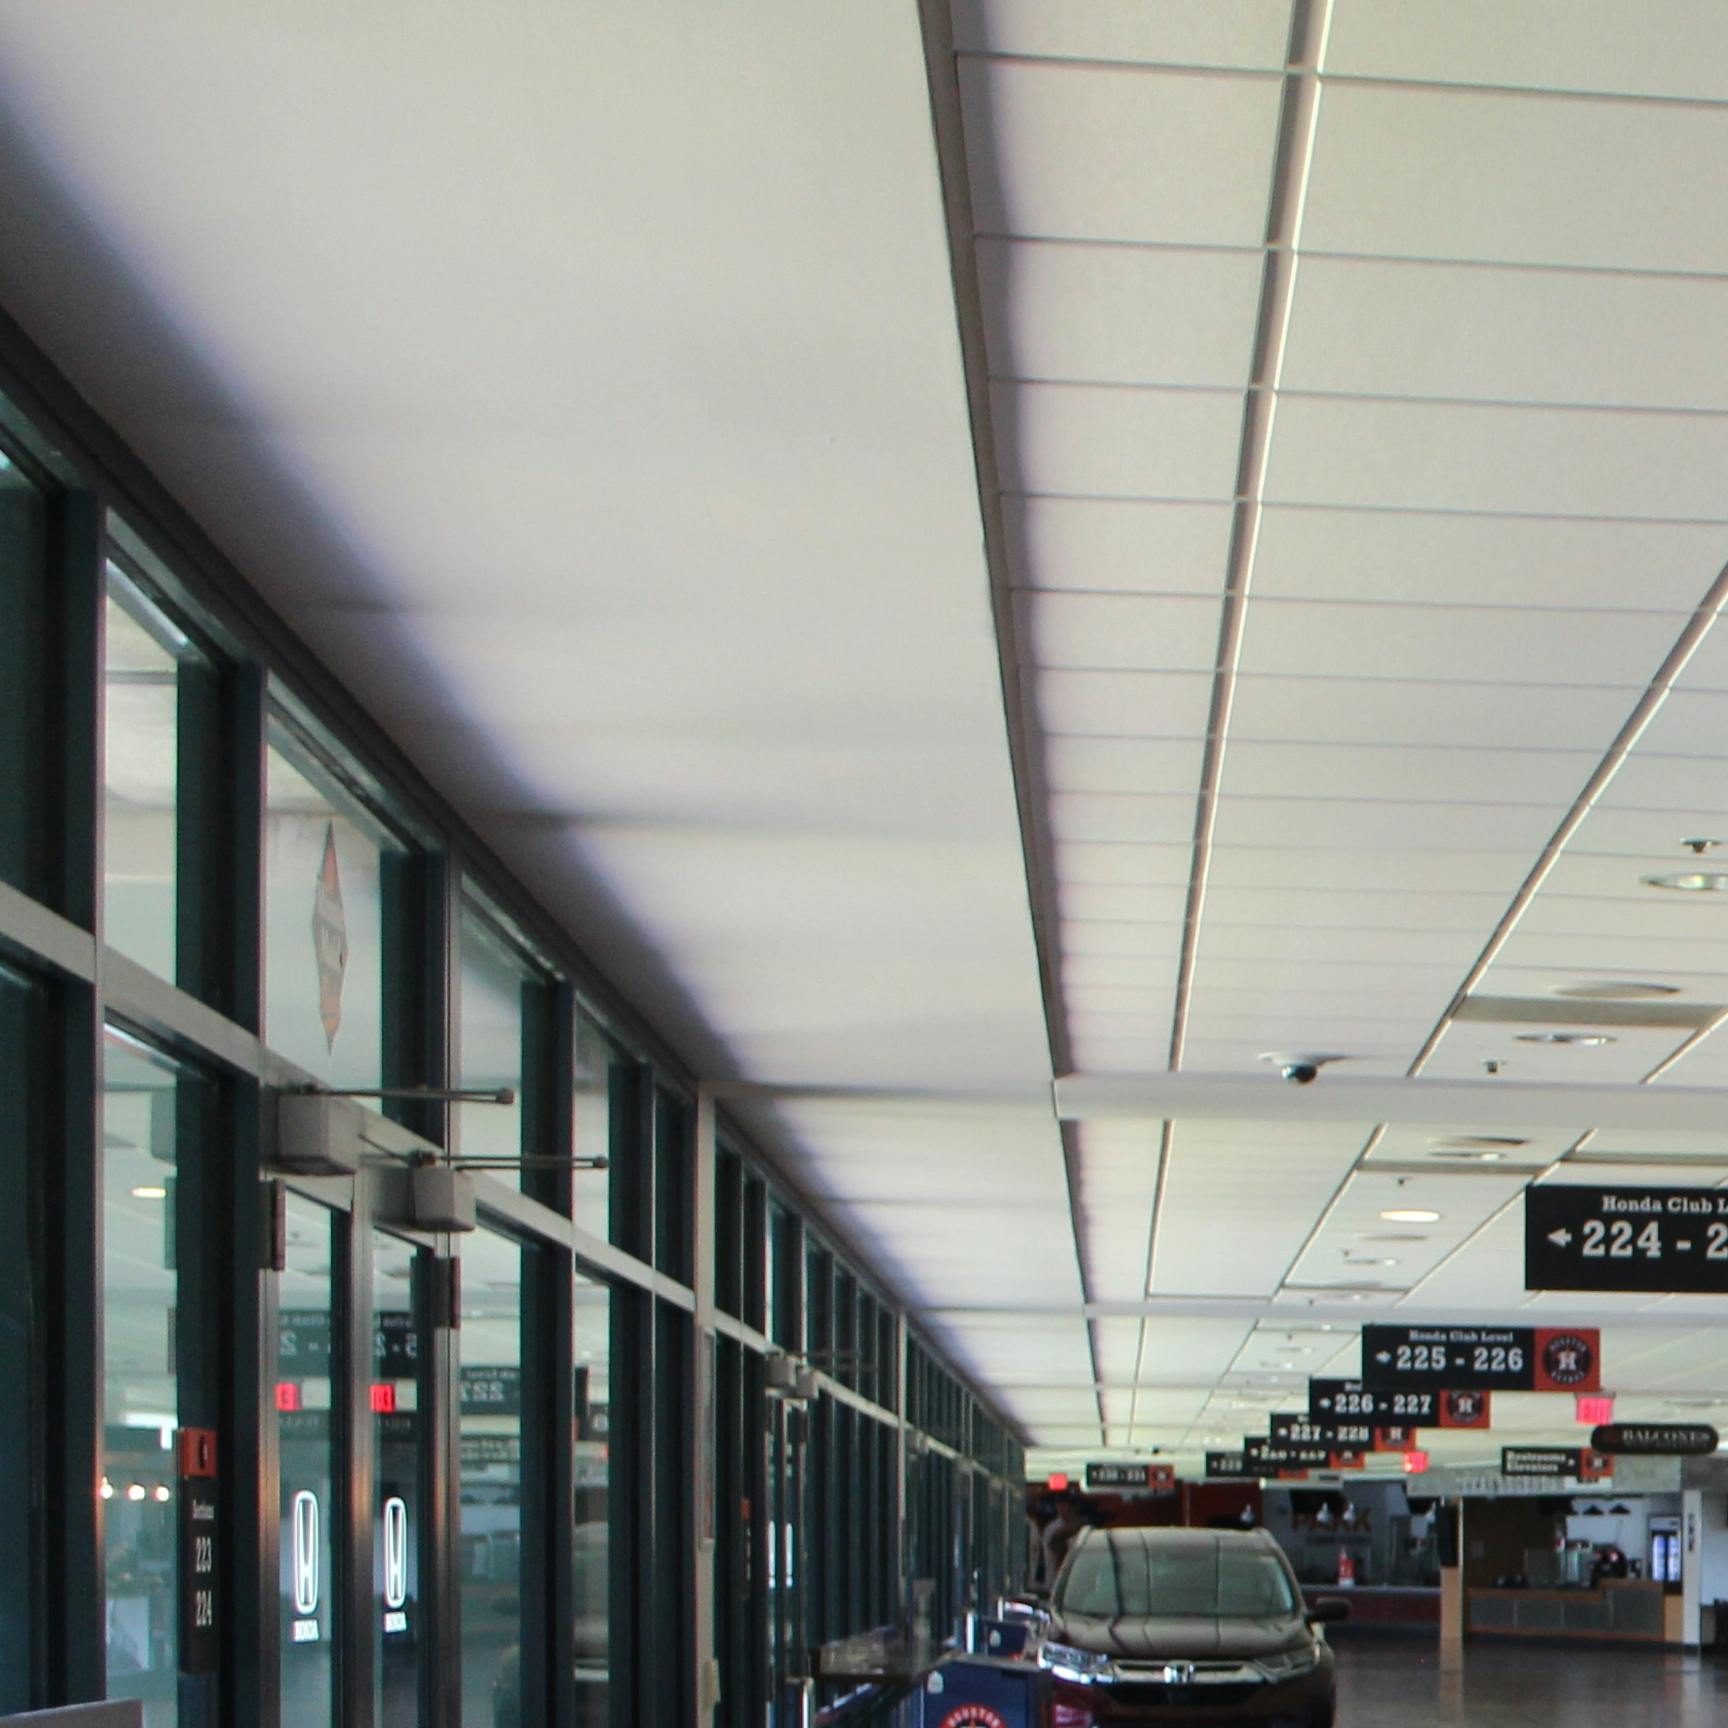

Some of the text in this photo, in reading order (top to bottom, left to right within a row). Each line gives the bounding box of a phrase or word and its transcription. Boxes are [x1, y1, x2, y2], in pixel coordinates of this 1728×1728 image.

[1602, 1195, 1662, 1213] Honda
[1667, 1197, 1712, 1214] Club
[1582, 1220, 1661, 1258] 224
[1409, 1330, 1513, 1344] Honda Club Level
[1396, 1345, 1447, 1371] 225
[1473, 1347, 1524, 1372] 226
[1334, 1394, 1374, 1414] 226
[1393, 1395, 1432, 1415] 227
[196, 1536, 212, 1573] 223
